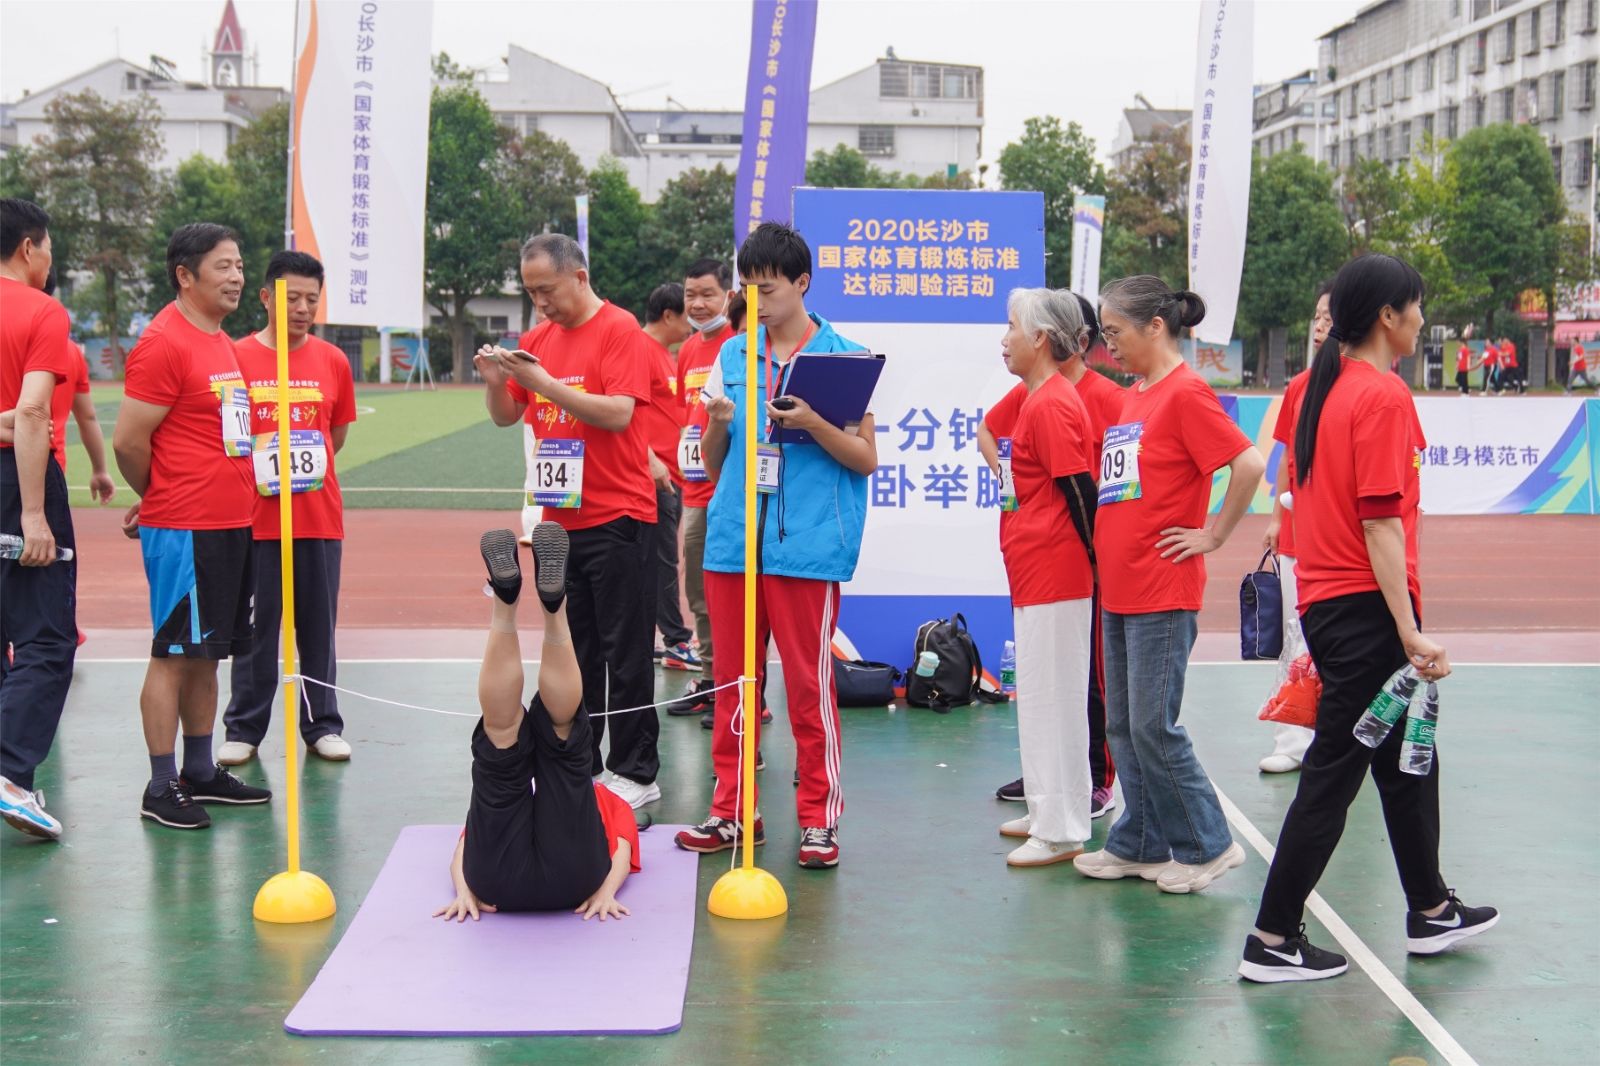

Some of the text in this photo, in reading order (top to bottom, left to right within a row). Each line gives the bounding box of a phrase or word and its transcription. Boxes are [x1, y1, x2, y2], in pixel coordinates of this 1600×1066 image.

[848, 219, 990, 243] 2020长沙市
[818, 245, 1020, 270] 国家体育锻炼标准
[843, 272, 995, 297] 达标测验活动
[235, 410, 251, 437] 10
[536, 461, 568, 488] 134
[1101, 448, 1126, 482] 09
